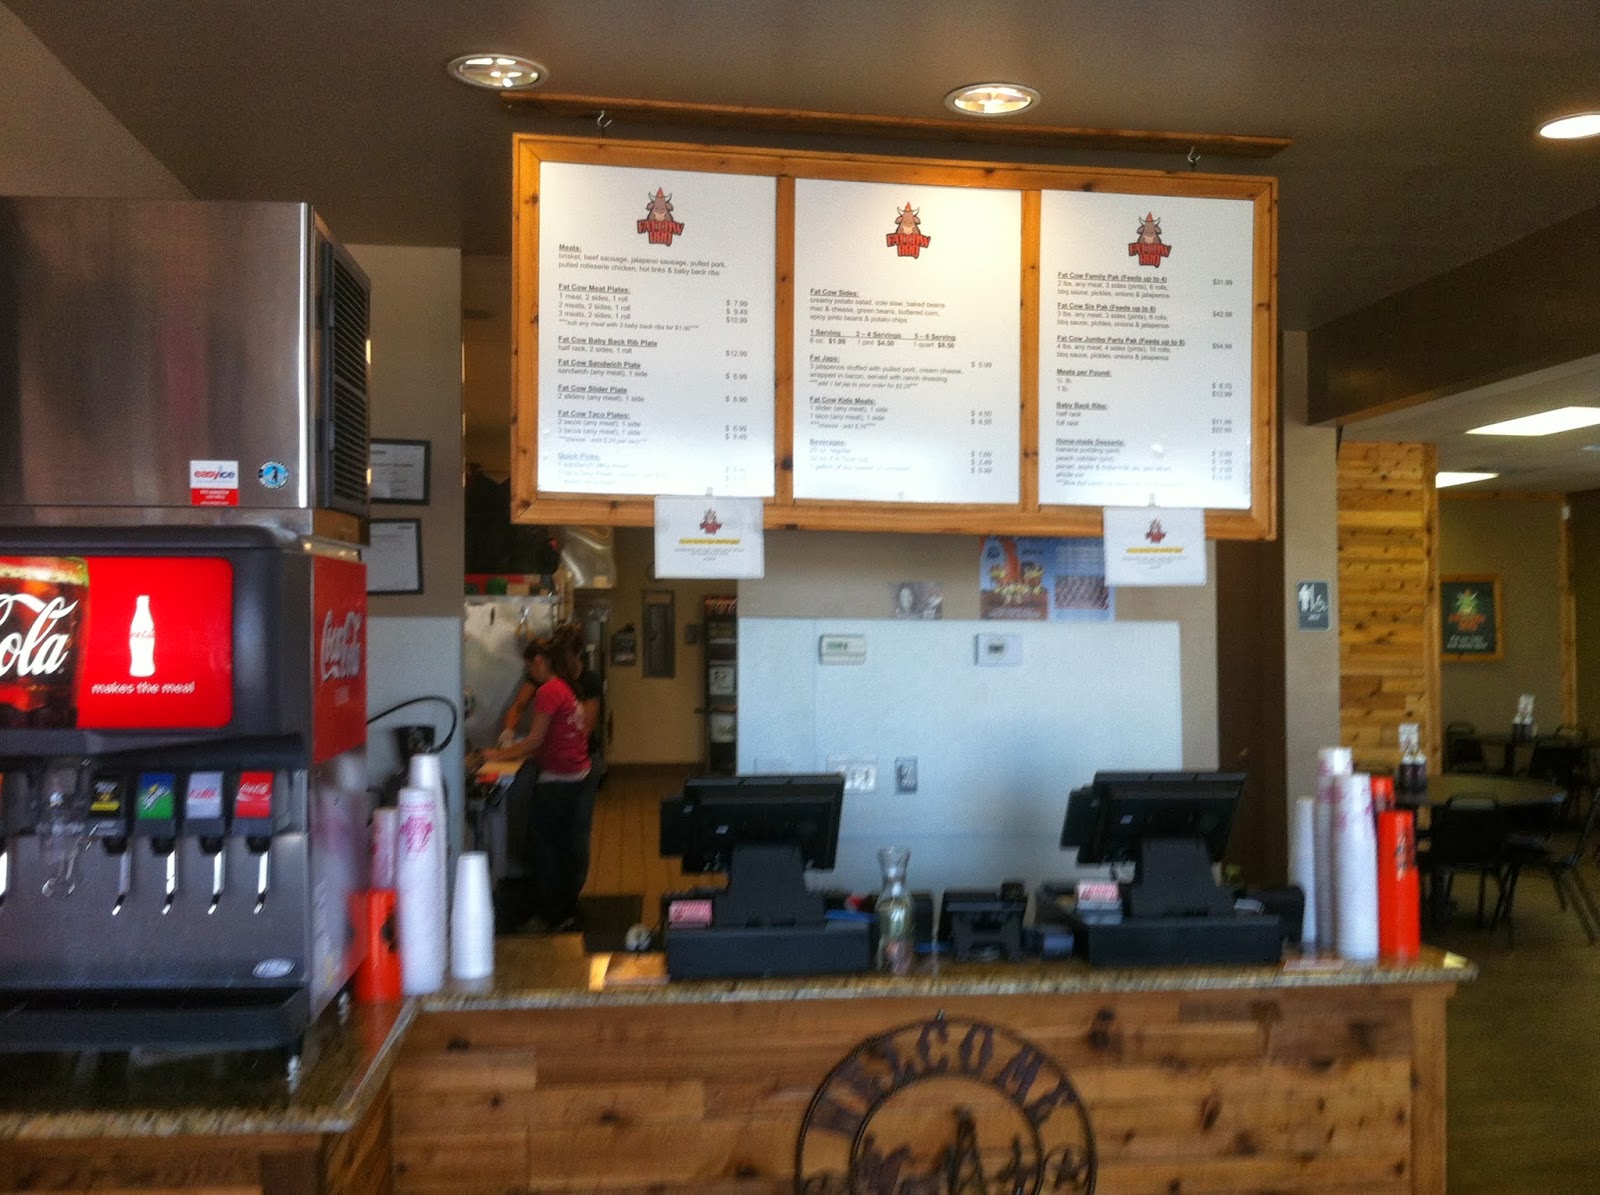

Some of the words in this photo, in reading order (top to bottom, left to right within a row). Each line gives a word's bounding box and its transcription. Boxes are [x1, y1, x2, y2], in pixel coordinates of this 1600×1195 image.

[583, 254, 598, 262] beef
[690, 259, 709, 269] pulled
[558, 261, 578, 271] pulled
[579, 262, 609, 271] rotisserie
[638, 265, 649, 273] hot
[650, 266, 665, 274] links
[673, 267, 689, 276] baby
[690, 268, 706, 276] back
[707, 269, 719, 277] ribs
[1057, 270, 1068, 279] Fat
[1069, 271, 1083, 280] Cow
[1084, 272, 1105, 281] Family
[1107, 273, 1118, 281] Pak
[1120, 273, 1141, 282] (Feeds
[1143, 275, 1151, 283] up
[1152, 274, 1159, 283] to
[1160, 275, 1167, 283] 4)
[558, 283, 569, 292] Fat
[571, 283, 586, 292] Cow
[588, 284, 605, 293] Meat
[810, 288, 820, 296] Fat
[822, 288, 836, 297] Cow
[1057, 288, 1069, 297] bbq
[1114, 290, 1134, 298] onions
[618, 294, 628, 302] roll
[734, 299, 748, 307] 7.99
[809, 298, 832, 306] creamy
[833, 297, 853, 306] potato
[874, 298, 887, 306] cole
[906, 300, 925, 308] baked
[926, 300, 945, 308] beans
[856, 308, 874, 316] green
[897, 308, 923, 316] buttered
[1057, 302, 1067, 310] Fat
[1068, 302, 1082, 311] Cow
[1084, 303, 1094, 311] Six
[1096, 303, 1107, 312] Pak
[1109, 304, 1130, 312] (Feeds
[1141, 304, 1148, 313] to
[1149, 305, 1156, 313] 6)
[809, 313, 825, 322] spicy
[827, 314, 842, 323] pinto
[843, 314, 862, 322] beans
[870, 315, 890, 325] potato
[890, 316, 907, 325] chips
[558, 336, 569, 344] Fat
[571, 336, 586, 345] Cow
[588, 336, 605, 345] Baby
[607, 337, 624, 346] Back
[627, 338, 638, 347] Rib
[640, 338, 657, 347] Plate
[1057, 334, 1067, 343] Fat
[1068, 335, 1082, 344] Cow
[1084, 335, 1105, 344] Jumbo
[1107, 336, 1123, 345] Party
[1125, 337, 1136, 345] Pak
[1138, 337, 1159, 346] (Feeds
[1170, 338, 1177, 347] to
[557, 344, 570, 352] half
[621, 346, 632, 354] roll
[809, 354, 820, 362] Fat
[558, 358, 569, 367] Fat
[570, 359, 586, 367] Cow
[588, 359, 621, 369] Sandwich
[623, 360, 640, 369] Plate
[1056, 368, 1075, 377] Meats
[557, 384, 569, 393] Fat
[570, 384, 586, 393] Cow
[588, 385, 607, 394] Slider
[609, 385, 627, 394] Plate
[809, 396, 820, 404] Fat
[821, 396, 836, 405] Cow
[837, 396, 852, 405] Kids
[557, 410, 568, 418] Fat
[570, 410, 586, 418] Cow
[588, 410, 604, 419] Taco
[91, 682, 135, 694] makes
[136, 681, 160, 694] the
[161, 681, 196, 694] meal
